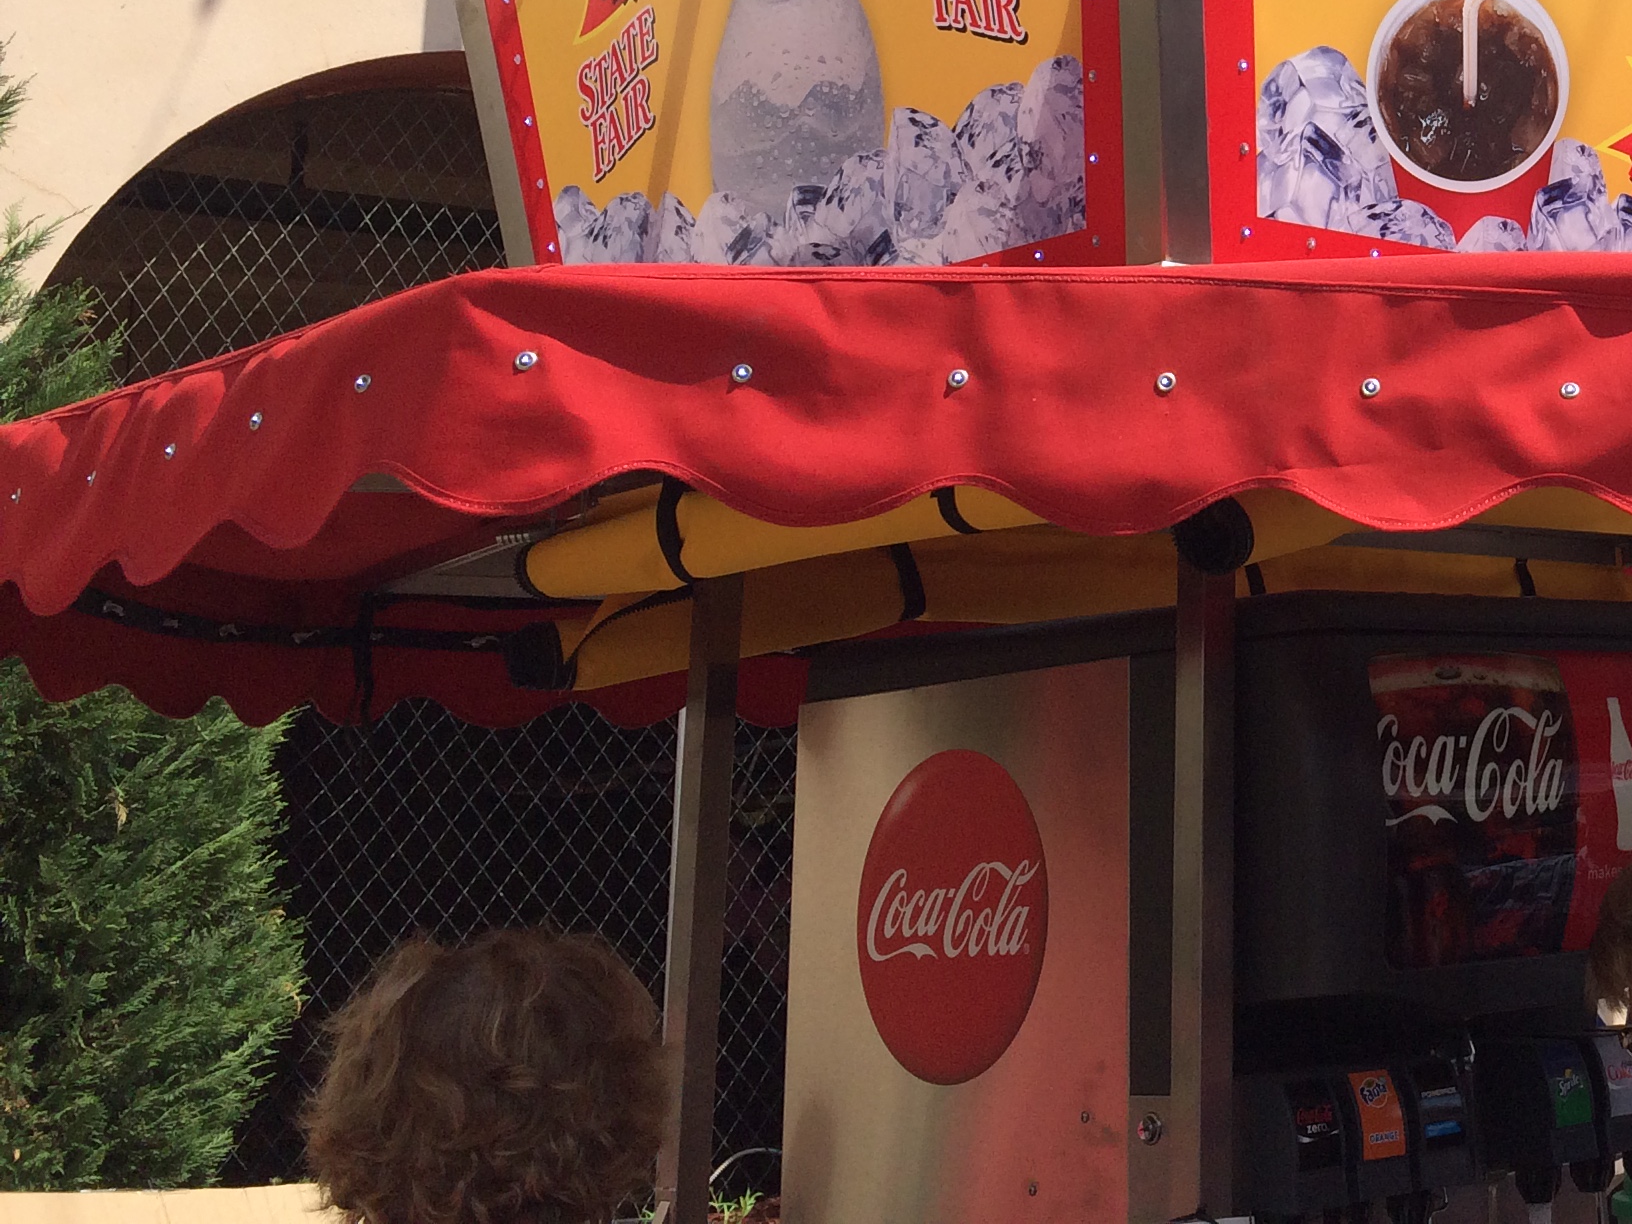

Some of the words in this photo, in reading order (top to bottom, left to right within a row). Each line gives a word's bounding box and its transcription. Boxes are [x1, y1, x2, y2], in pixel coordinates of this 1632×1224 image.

[577, 6, 658, 124] STATE
[589, 74, 656, 180] FAIR
[866, 859, 1041, 962] Coca-Cola
[1306, 1122, 1328, 1134] zero
[1369, 1130, 1399, 1144] ORANGE
